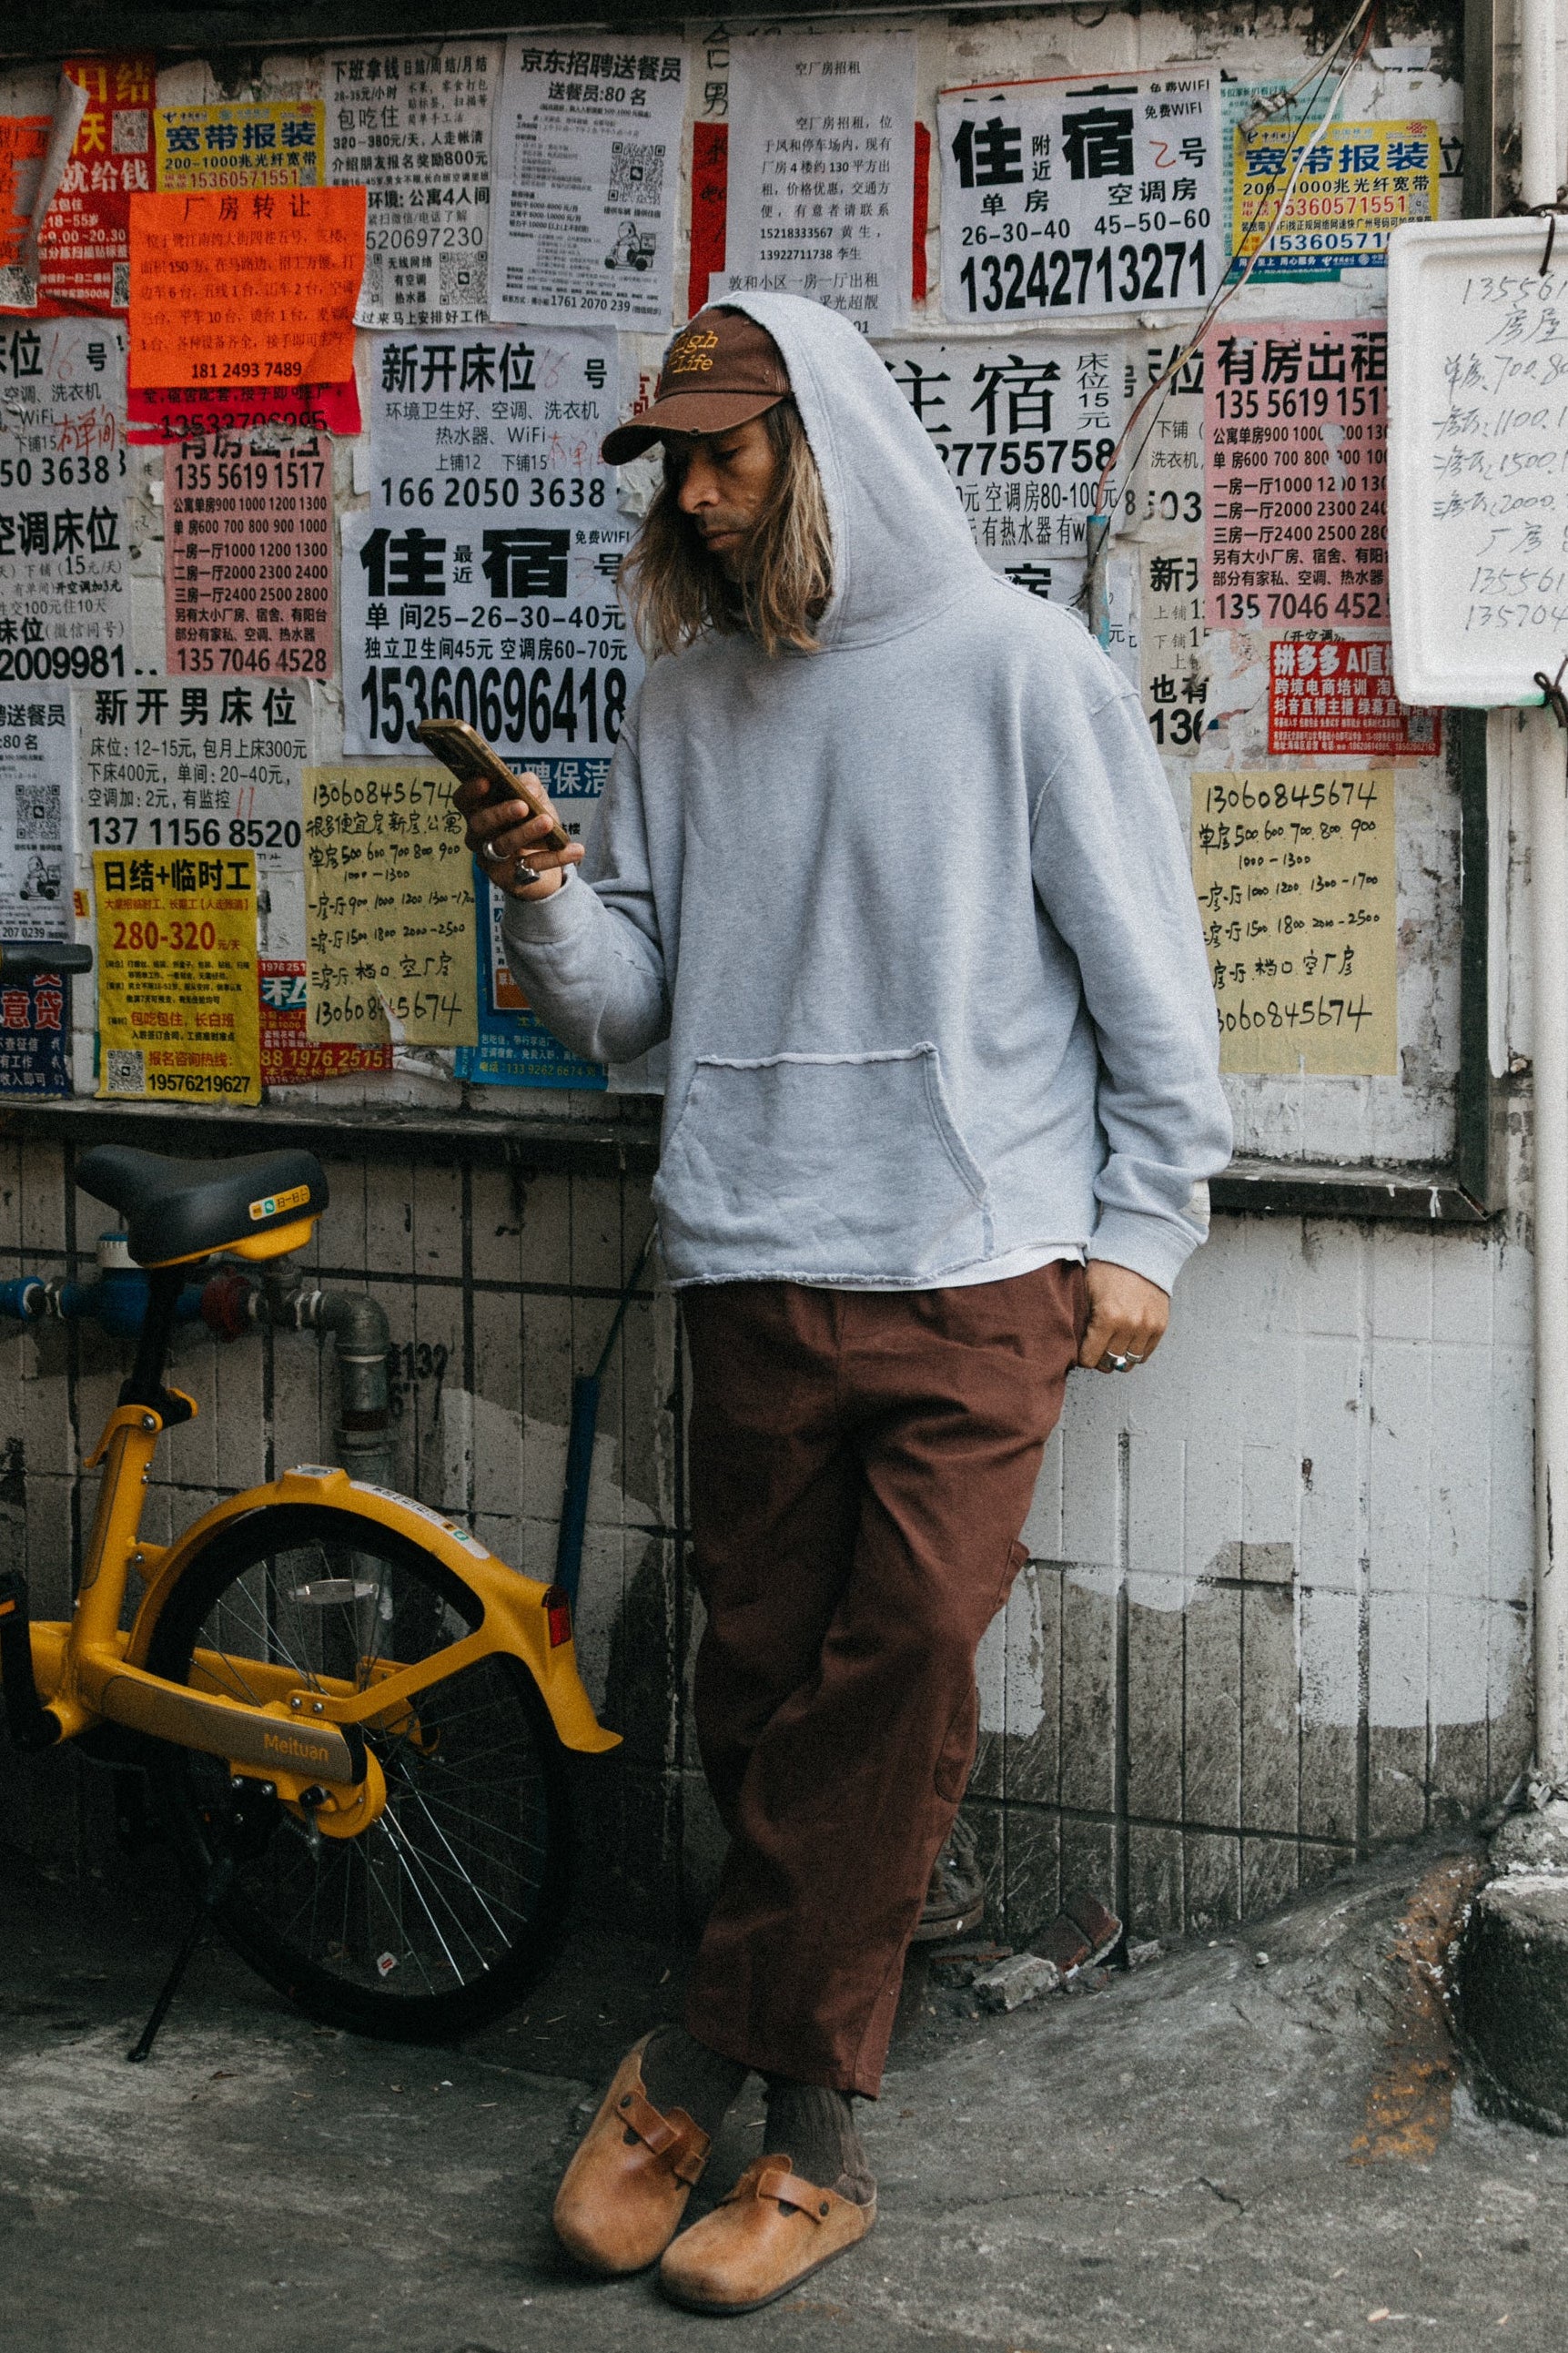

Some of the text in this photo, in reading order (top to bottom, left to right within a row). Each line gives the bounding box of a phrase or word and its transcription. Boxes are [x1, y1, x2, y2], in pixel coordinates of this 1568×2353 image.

[521, 47, 681, 83] 京东招聘送餐员
[795, 60, 861, 76] 空厂房招租
[338, 105, 399, 131] 包吃住
[1144, 102, 1202, 119] 免费WIFI
[166, 120, 316, 153] 宽带报装
[1179, 137, 1207, 167] 号
[1245, 141, 1430, 177] 宽带报装
[190, 168, 298, 188] 15360571551
[1108, 177, 1198, 207] 空调房
[184, 193, 311, 220] 厂房转让
[962, 208, 1210, 246] 26-30-40 45-50-60
[960, 239, 1206, 312] 13242713271
[551, 295, 631, 312] 1761 2070 239
[86, 342, 107, 371] 号
[381, 342, 607, 393] 新开床位 号
[673, 353, 713, 373] Life
[1218, 331, 1388, 386] 有房出租
[192, 361, 302, 379] 181 2493 7489
[386, 401, 600, 421] 环境卫生好、空调、洗衣机
[1216, 386, 1388, 419] 135 5619 151
[20, 410, 54, 425] WiFi
[1213, 426, 1289, 444] 公寓单房900
[42, 456, 109, 486] 3638
[435, 454, 548, 472] 上铺12 下铺15
[1274, 451, 1298, 466] 700
[1304, 451, 1329, 466] 800
[175, 461, 325, 490] 135 5619 1517
[1213, 477, 1312, 494] 一房一厅1000
[173, 496, 327, 512] 公寓单房900 1000 1200 1300
[380, 477, 605, 507] 166 2050 3638
[1213, 501, 1356, 519] 二房一厅2000 2300
[224, 520, 244, 532] 700
[248, 520, 268, 532] 800
[274, 519, 294, 532] 900
[300, 519, 327, 532] 1000
[575, 530, 630, 545] 免费WIFI
[1213, 525, 1356, 543] 三房一厅2400 2500
[174, 543, 328, 559] 一房一厅1000 1200 1300
[174, 564, 328, 581] 二房一厅2000 2300 2400
[1213, 570, 1384, 586] 部分有家私、空调、热水器
[175, 587, 328, 603] 三房一厅2400 2500 2800
[1216, 593, 1390, 619] 135 7046 452
[177, 648, 327, 672] 135 7046 4528
[365, 637, 628, 660] 独立卫生间45元 空调房60-70元
[1274, 644, 1340, 676] 拼多多
[0, 644, 124, 681] 2009981
[1275, 678, 1367, 695] 跨境电商培训
[95, 686, 297, 727] 新开男床位
[361, 665, 627, 745] 15360696418
[1274, 698, 1354, 715] 抖音直播主播
[313, 777, 455, 808] 13060845674
[1207, 780, 1377, 814] 13060845674
[88, 817, 301, 848] 137 1156 8520
[105, 859, 251, 892] 日结+临时工
[113, 921, 216, 951] 280-320
[260, 1049, 383, 1068] 88 1976 2515
[148, 1074, 250, 1093] 19576219627
[263, 1733, 329, 1761] Meituan
